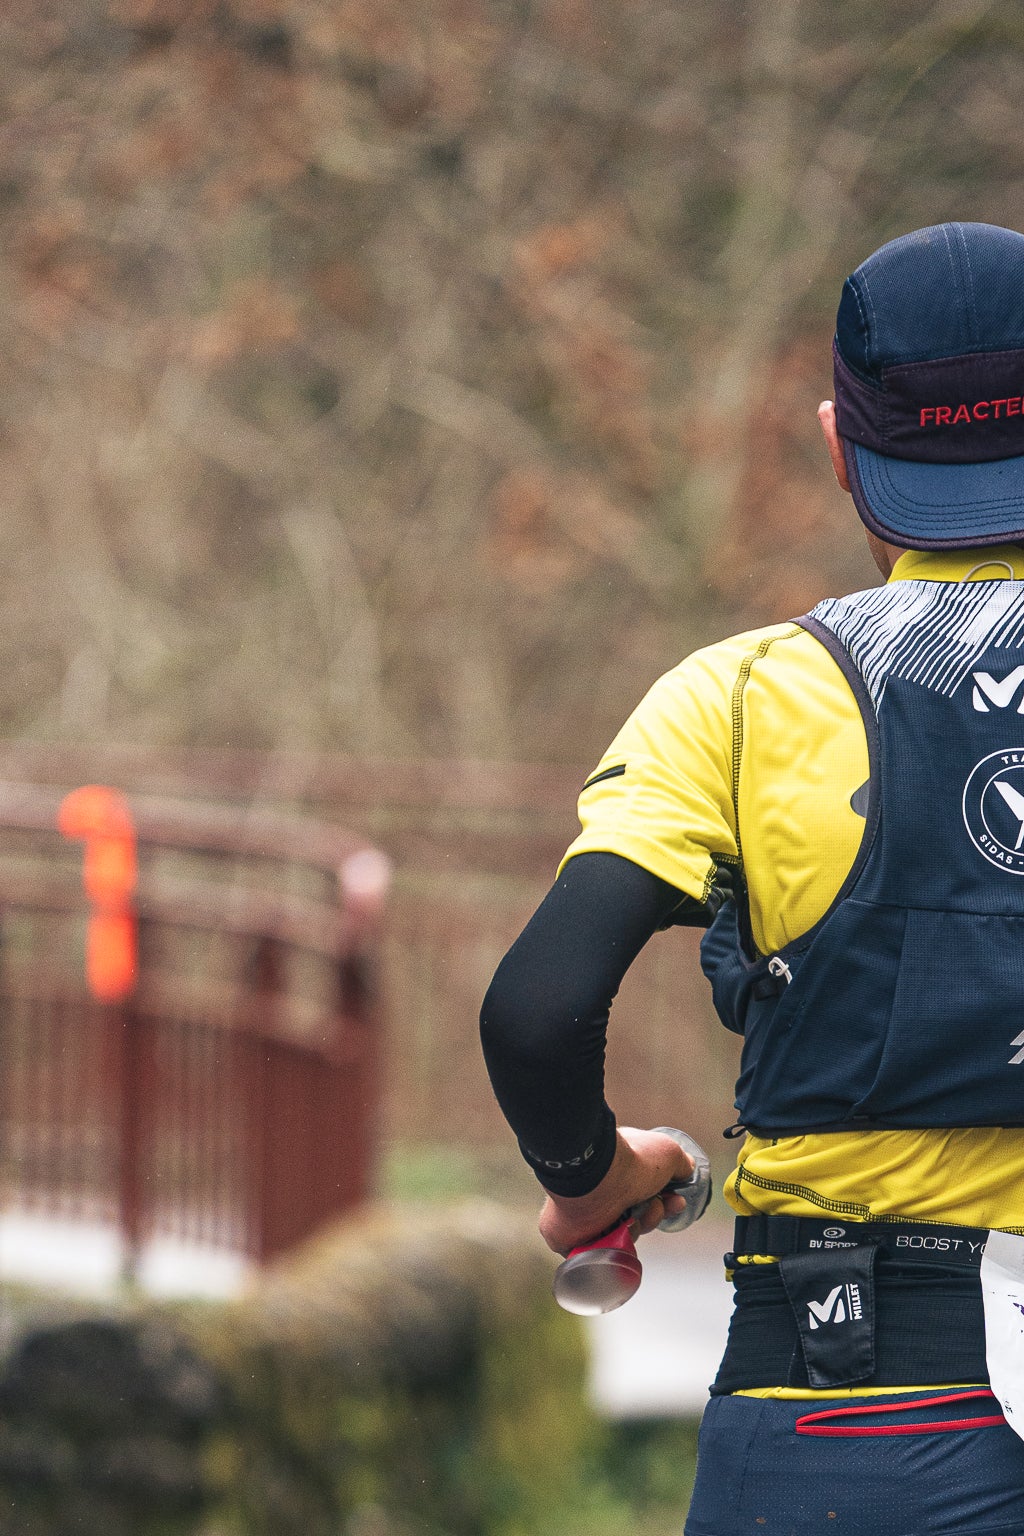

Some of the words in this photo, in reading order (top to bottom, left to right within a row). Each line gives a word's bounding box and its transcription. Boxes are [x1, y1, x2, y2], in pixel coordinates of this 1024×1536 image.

[980, 834, 1013, 865] SIDAS
[809, 1239, 823, 1249] BV
[896, 1235, 964, 1251] BOOST
[849, 1283, 863, 1320] MILLET
